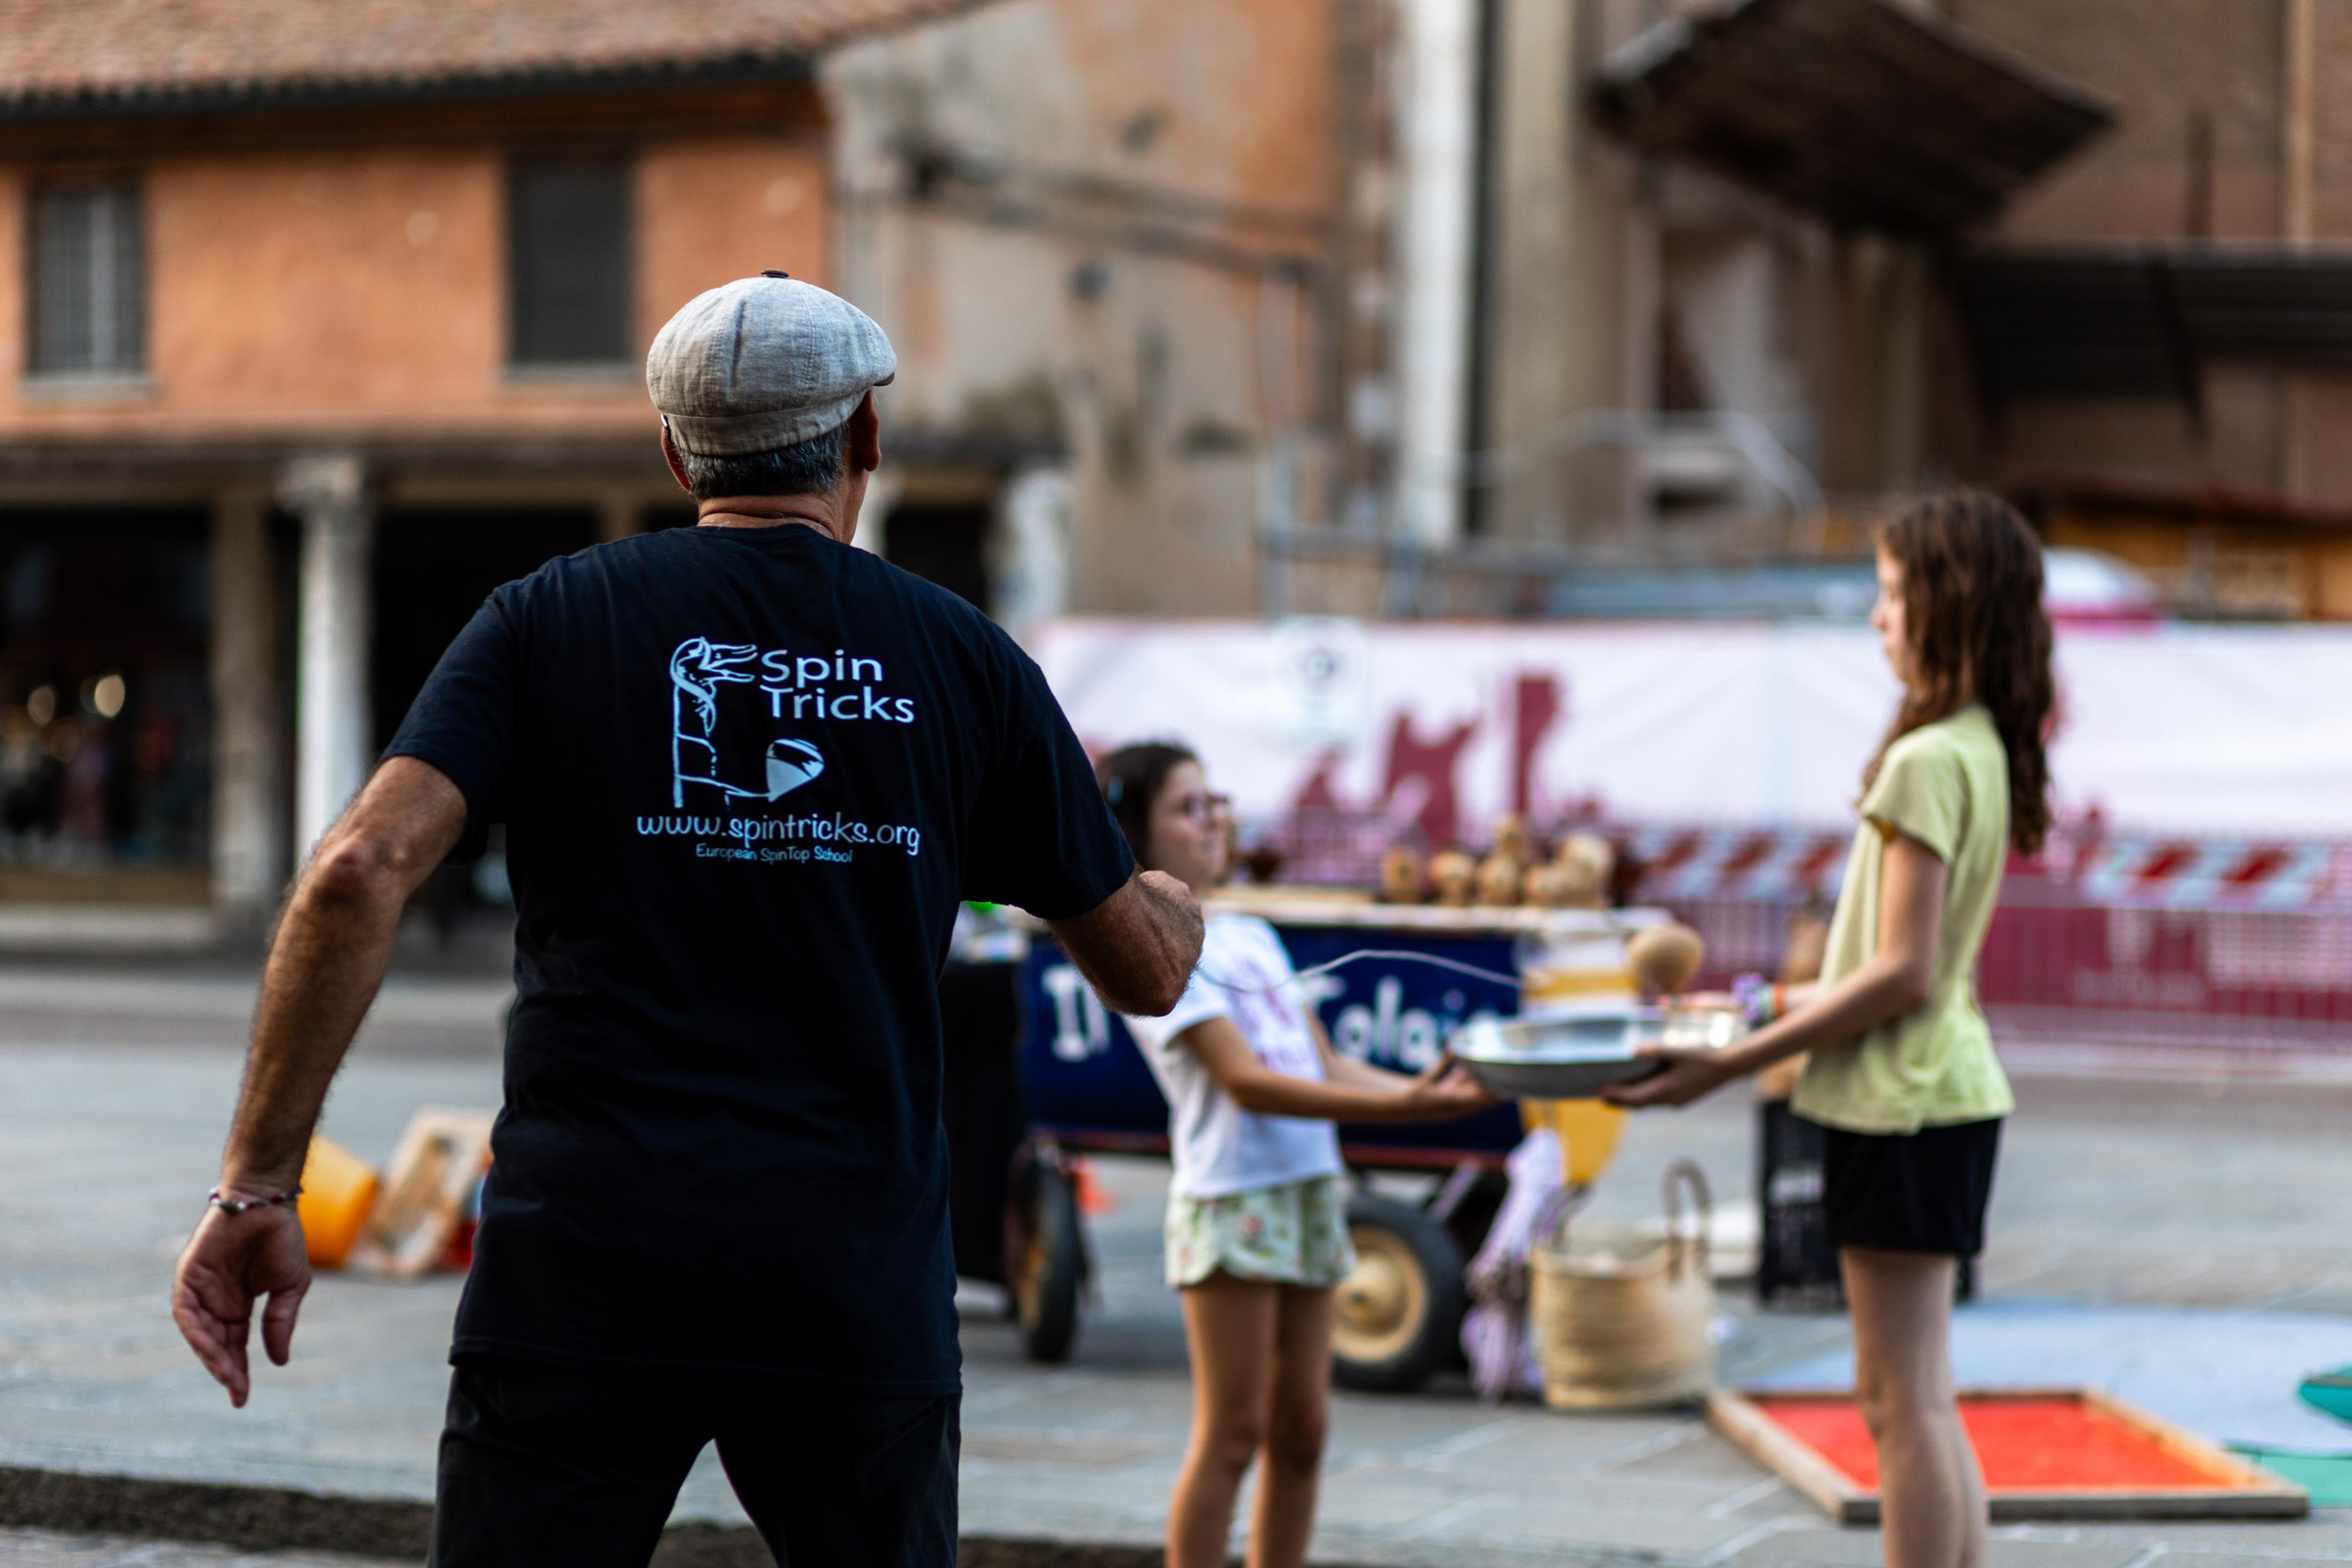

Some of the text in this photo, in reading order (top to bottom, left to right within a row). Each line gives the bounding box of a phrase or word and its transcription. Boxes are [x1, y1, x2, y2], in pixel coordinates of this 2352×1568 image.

[760, 649, 884, 689] Spin
[759, 683, 916, 724] Tricks
[637, 811, 921, 857] www.spintricks.org
[695, 842, 854, 864] European SpinTop School
